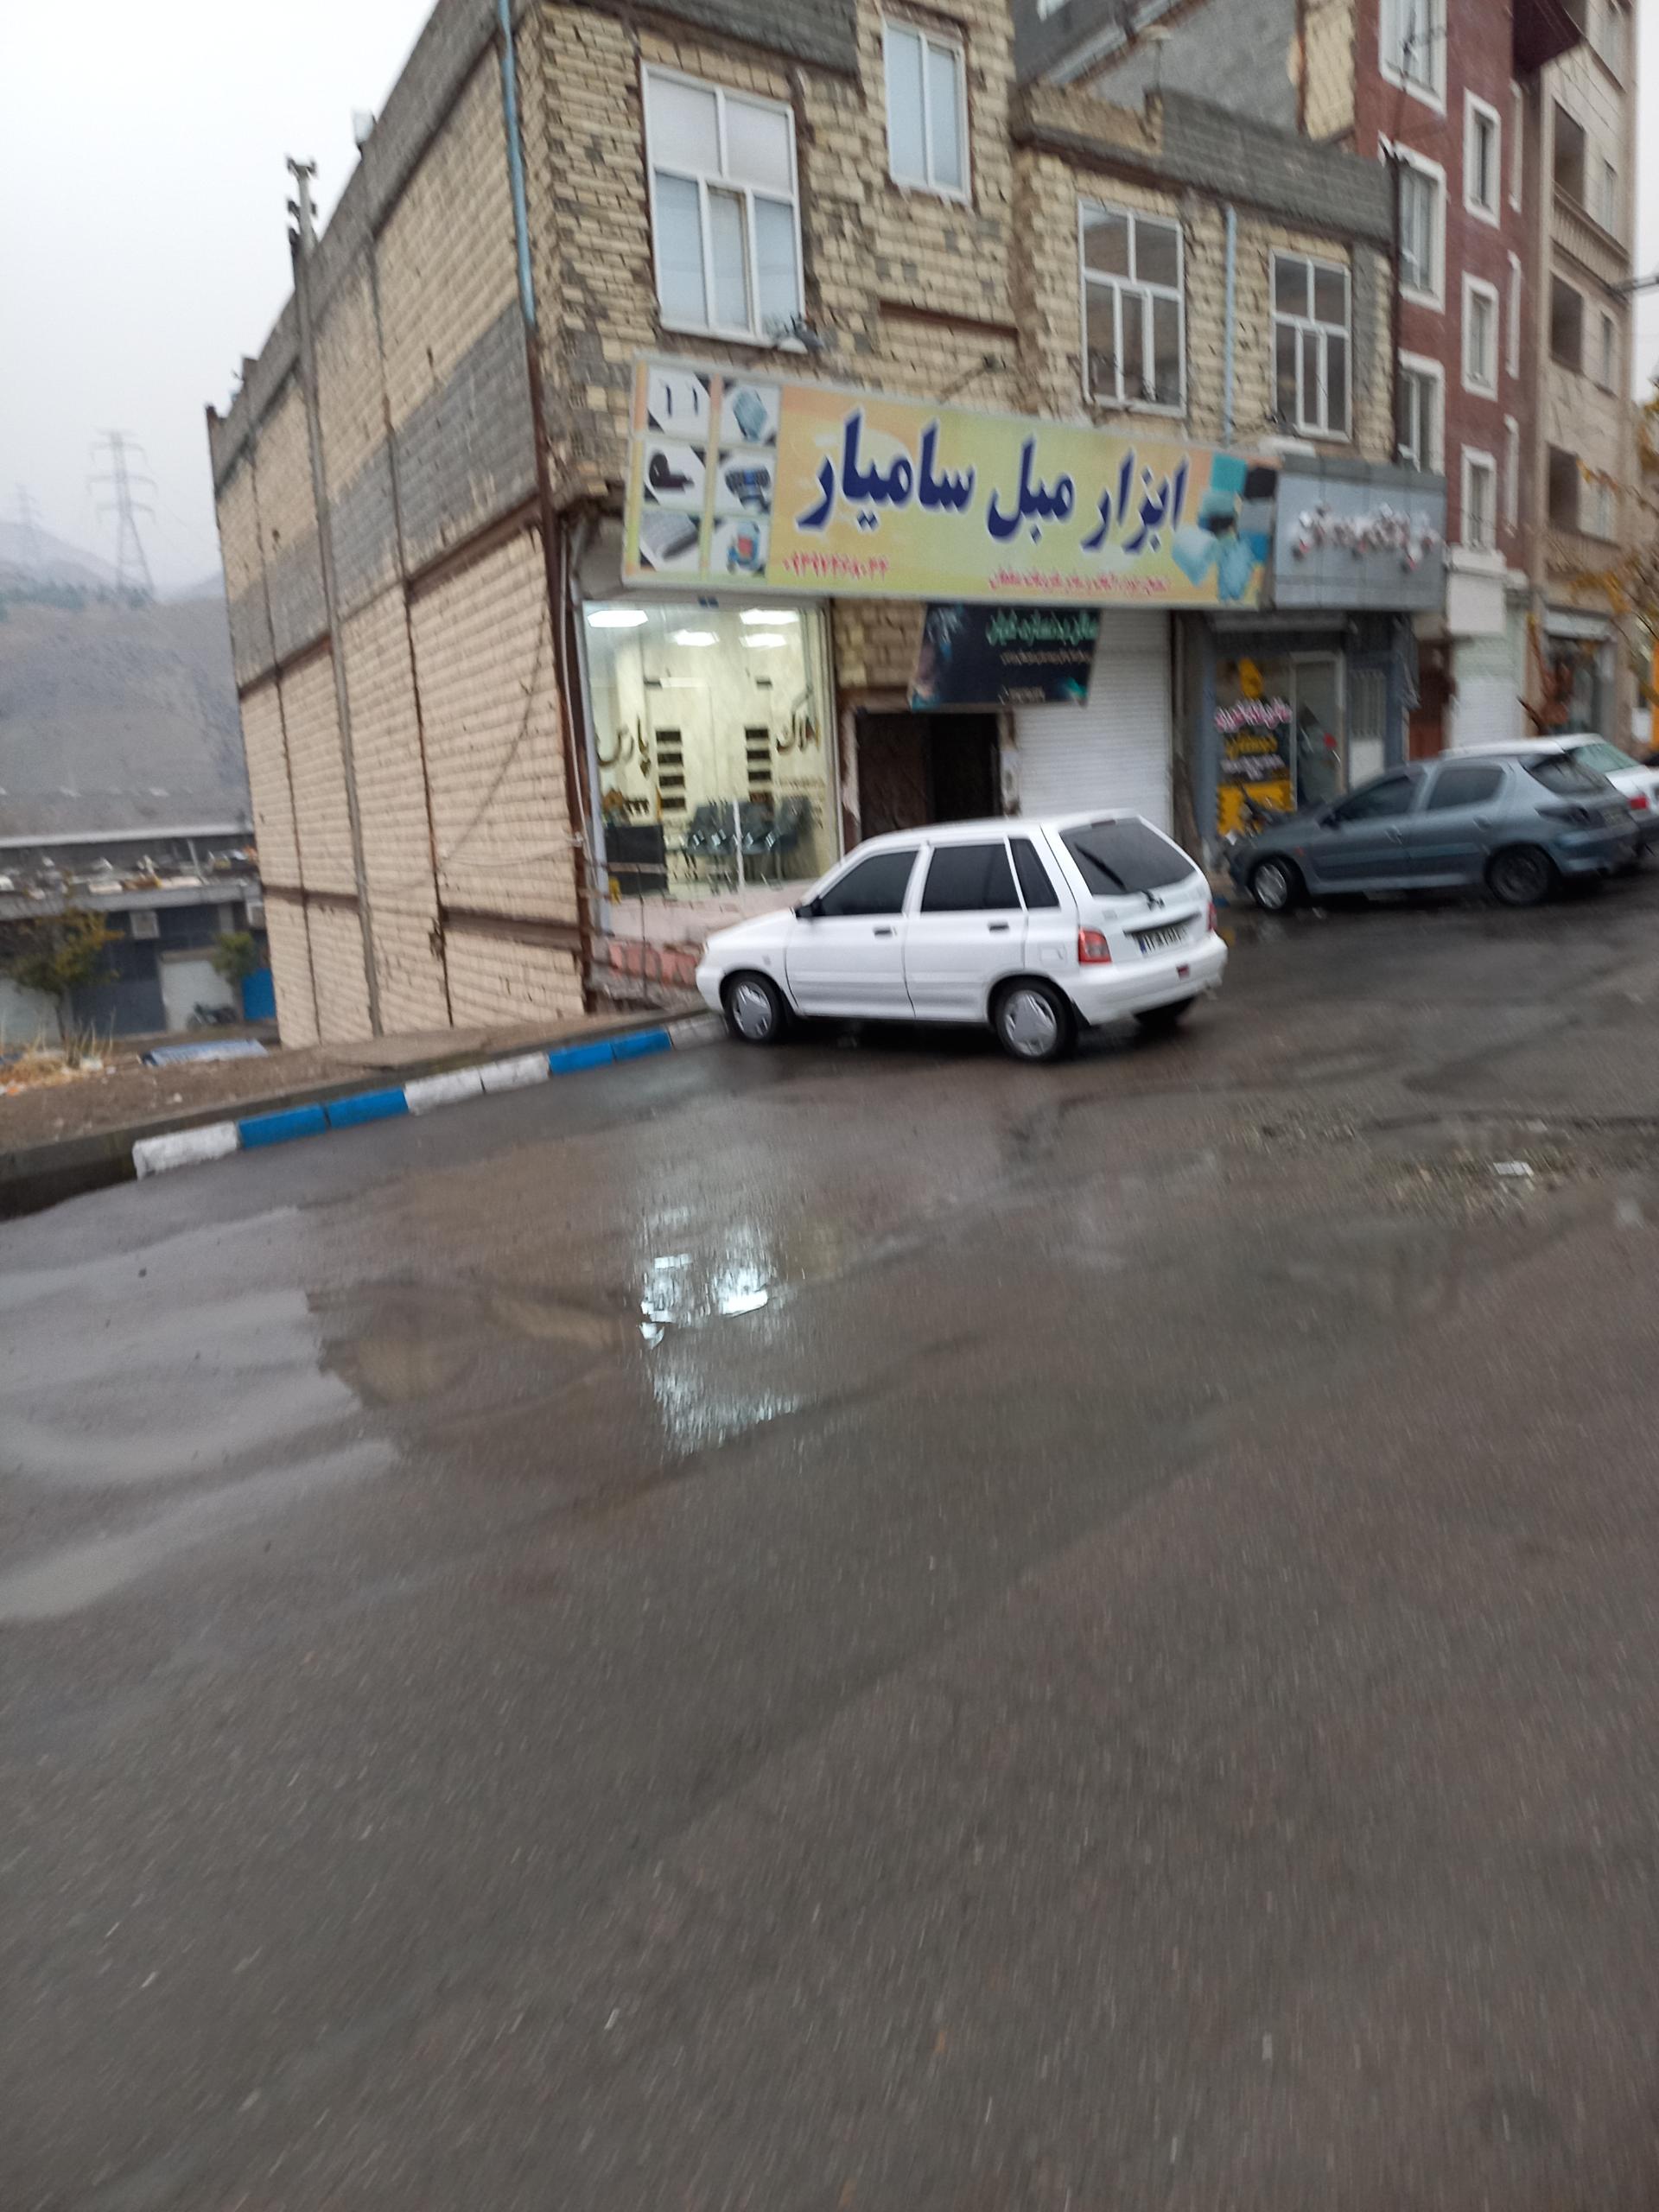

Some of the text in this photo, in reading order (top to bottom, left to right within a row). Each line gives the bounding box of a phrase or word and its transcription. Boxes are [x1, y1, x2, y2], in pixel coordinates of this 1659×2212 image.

[796, 409, 976, 531] سامیار
[988, 433, 1075, 544] مبل
[1080, 448, 1189, 554] ابزار
